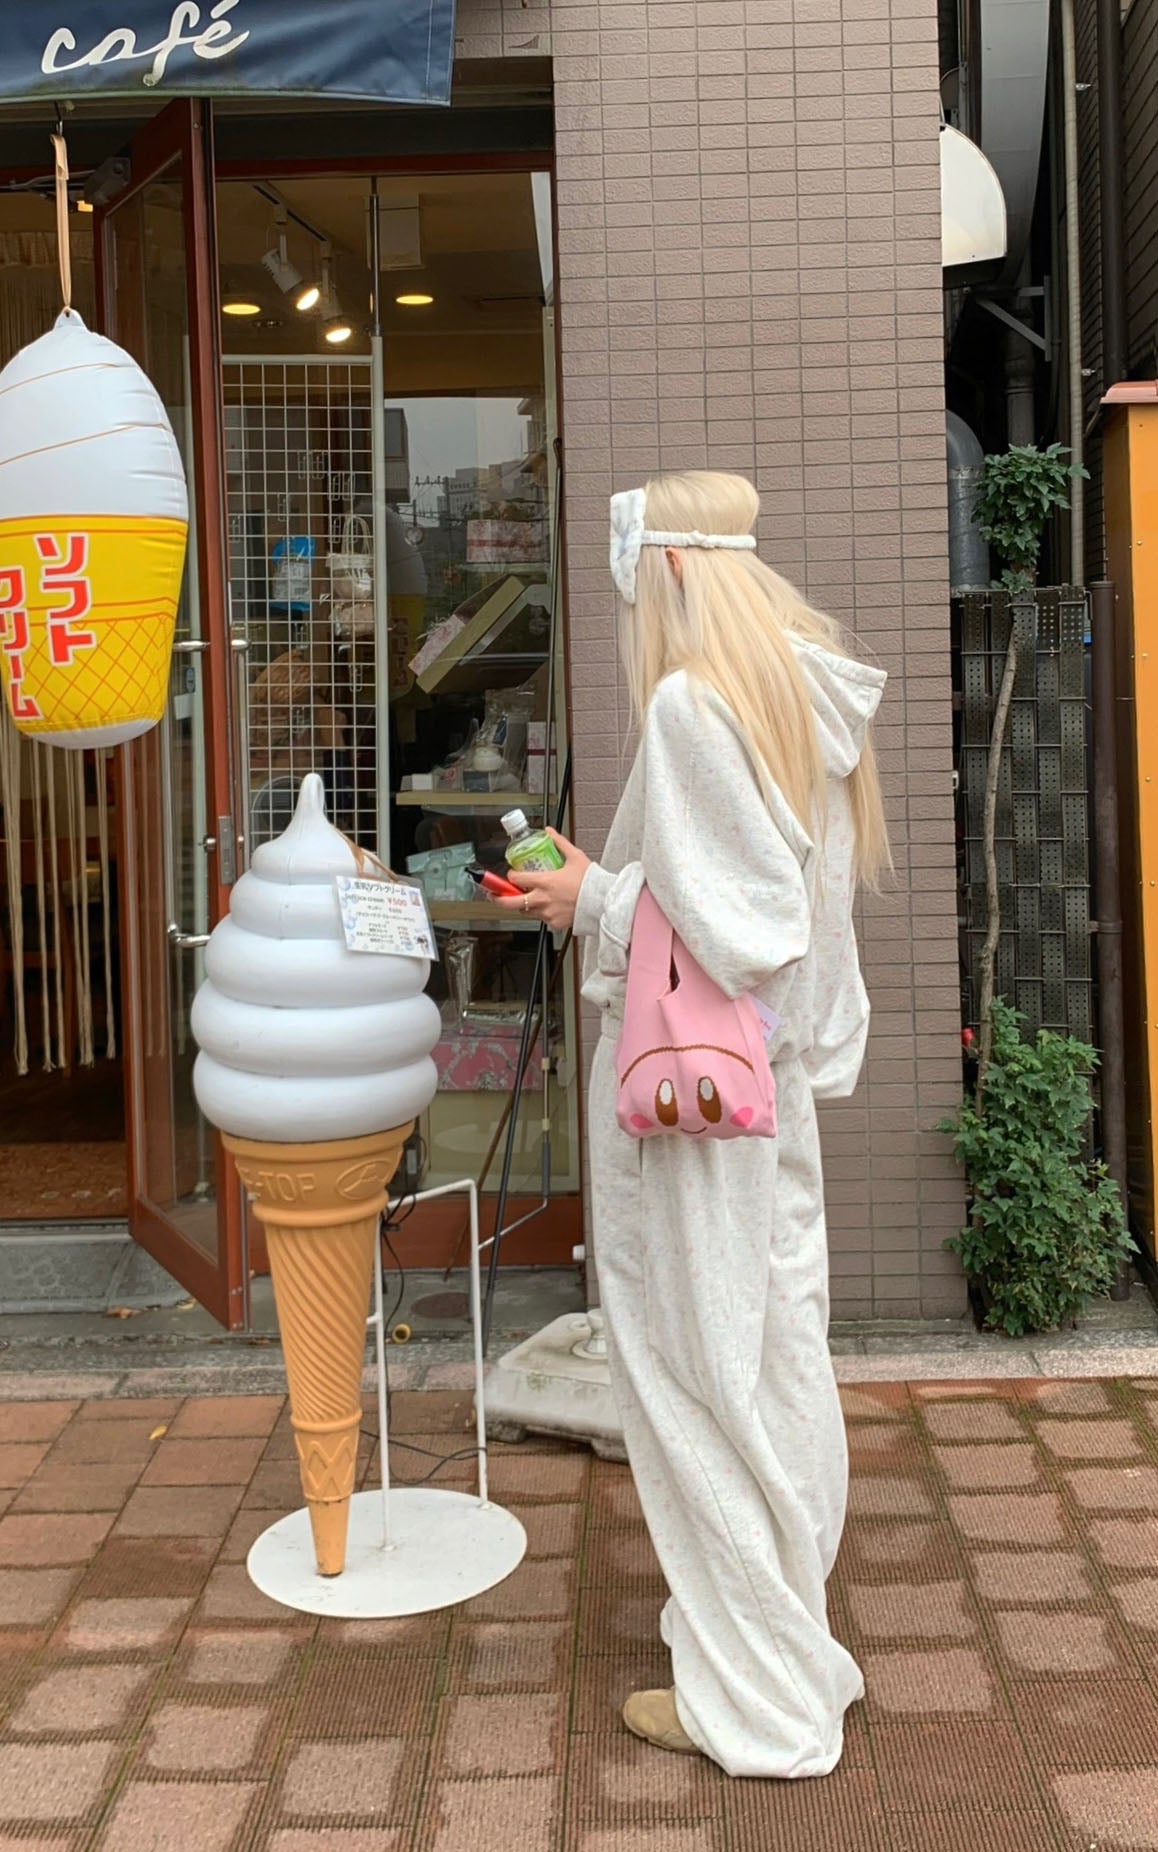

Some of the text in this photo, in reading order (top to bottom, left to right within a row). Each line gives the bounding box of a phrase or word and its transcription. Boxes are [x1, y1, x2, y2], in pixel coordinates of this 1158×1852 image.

[41, 0, 250, 87] café
[36, 534, 94, 664] ソフト
